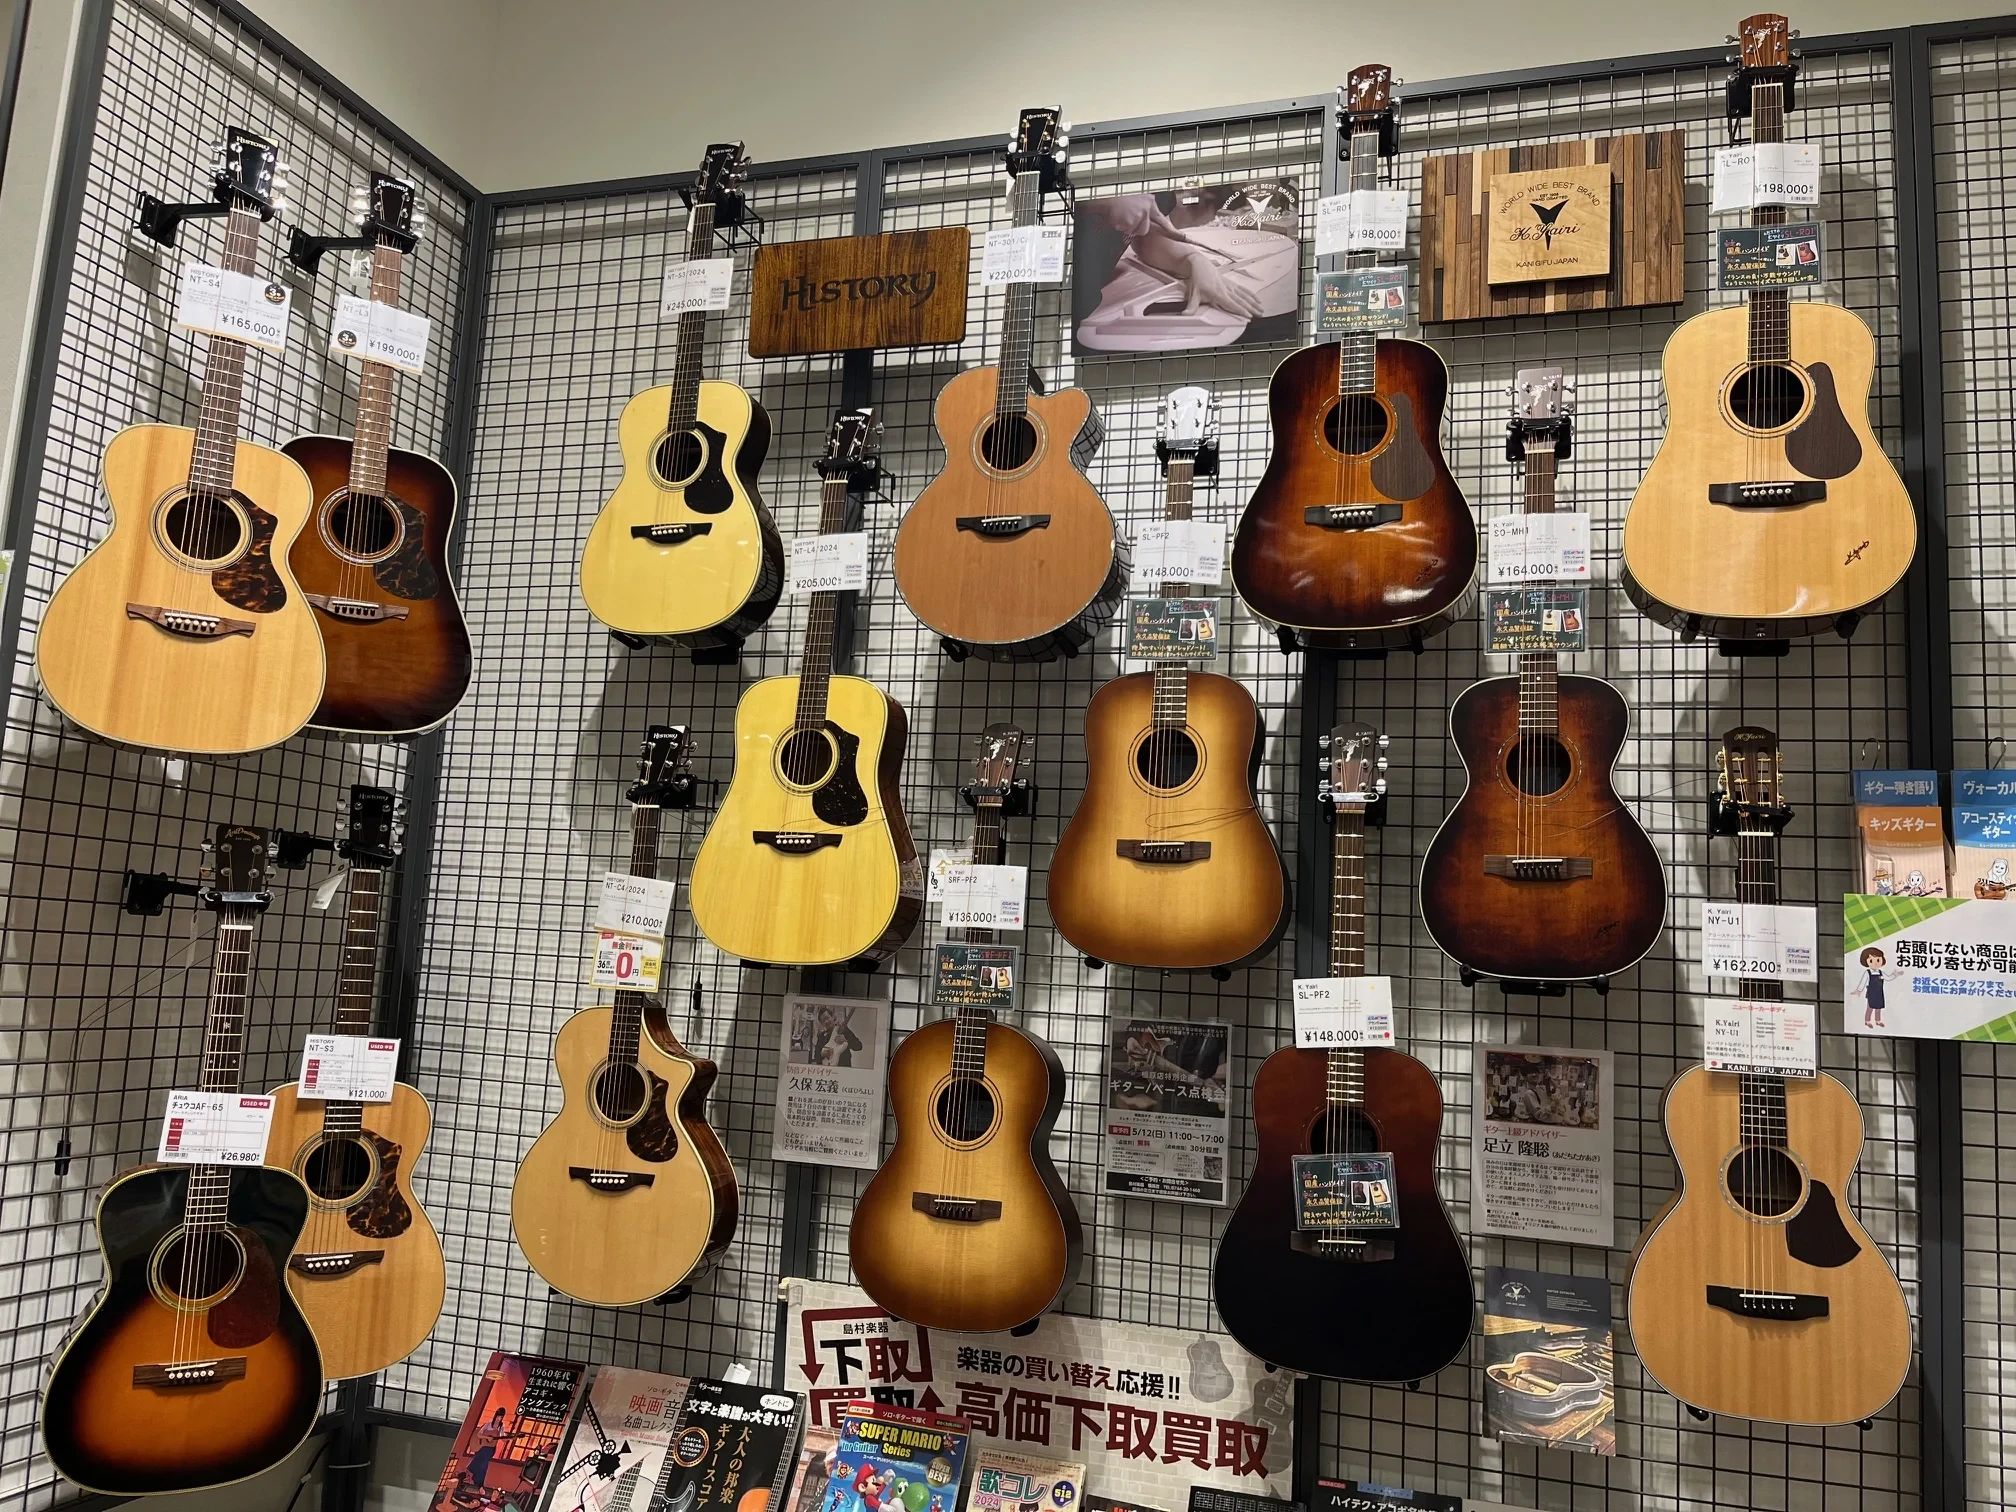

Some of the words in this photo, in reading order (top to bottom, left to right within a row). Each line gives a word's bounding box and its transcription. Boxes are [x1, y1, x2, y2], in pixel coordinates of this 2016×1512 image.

[236, 135, 270, 151] HISTORY
[1222, 191, 1240, 210] WORLD
[1242, 184, 1258, 194] WIDE
[1278, 186, 1295, 203] BRAND
[1500, 191, 1524, 215] WORLD
[1527, 182, 1549, 193] WIDE
[1552, 181, 1575, 189] BEST
[1577, 185, 1601, 207] BRAND
[1553, 257, 1579, 265] JAPAN
[190, 274, 220, 288] NT-S4
[778, 271, 937, 312] HISTORY
[222, 313, 275, 337] ¥165,000
[369, 339, 415, 360] ¥199,000
[1142, 532, 1170, 541] SL-PF2
[1142, 566, 1190, 578] ¥148,000
[1498, 563, 1553, 577] ¥164,000
[1864, 780, 1934, 796] ギター弾き語り
[1870, 817, 1937, 832] キッズギター
[1982, 825, 2011, 839] ギター
[948, 876, 978, 884] SRF-PF2
[605, 882, 646, 895] NT-C4/2024
[621, 913, 659, 928] ¥210,000
[949, 912, 992, 923] ¥136,000
[1708, 916, 1740, 926] NY-U1
[1713, 958, 1776, 974] ¥162,200
[1912, 976, 2004, 989] お近くのスタッフまで
[1298, 990, 1330, 1000] SL-PF2
[1715, 1019, 1740, 1028] K.Yairi
[1304, 1029, 1359, 1042] ¥148,000
[1715, 1028, 1739, 1037] NY-U1
[309, 1044, 335, 1053] NT-S3
[1780, 1068, 1809, 1076] JAPAN
[789, 1076, 813, 1092] 久保
[815, 1078, 839, 1094] 宏義
[349, 1089, 385, 1099] ¥121,000
[171, 1101, 224, 1112] チュウコAF-65
[1132, 1128, 1166, 1139] 5/12(日)
[1483, 1124, 1569, 1139] ギター上級アドバイザー
[1482, 1137, 1515, 1155] 足立
[1518, 1140, 1550, 1158] 隆聡
[221, 1151, 257, 1162] ¥26,980
[843, 1321, 889, 1335] 島村楽器
[819, 1336, 933, 1386] 下取
[531, 1367, 571, 1381] 1960年代
[957, 1346, 1181, 1401] 楽器の買い替え応援!!
[528, 1376, 575, 1392] 生まれに響く！
[647, 1385, 684, 1399] ソロ・ギターで
[520, 1397, 568, 1411] ソングブック
[628, 1393, 681, 1420] 映画音
[764, 1398, 790, 1408] ホントに
[686, 1399, 795, 1428] 文字と楽譜が大きい!!
[882, 1411, 927, 1424] ソロ・ギターで弾く
[859, 1421, 899, 1442] SUPER
[899, 1429, 942, 1451] MARIO
[954, 1381, 1270, 1480] 高価下取買取
[841, 1440, 854, 1452] for
[853, 1441, 878, 1454] Guitar
[882, 1442, 911, 1458] Series
[696, 1423, 733, 1511] ギタースコア
[718, 1426, 753, 1504] 大人の邦楽
[931, 1461, 951, 1473] SUPER
[978, 1466, 1048, 1502] 歌コレ
[1054, 1489, 1072, 1498] 512
[974, 1495, 999, 1507] 2024
